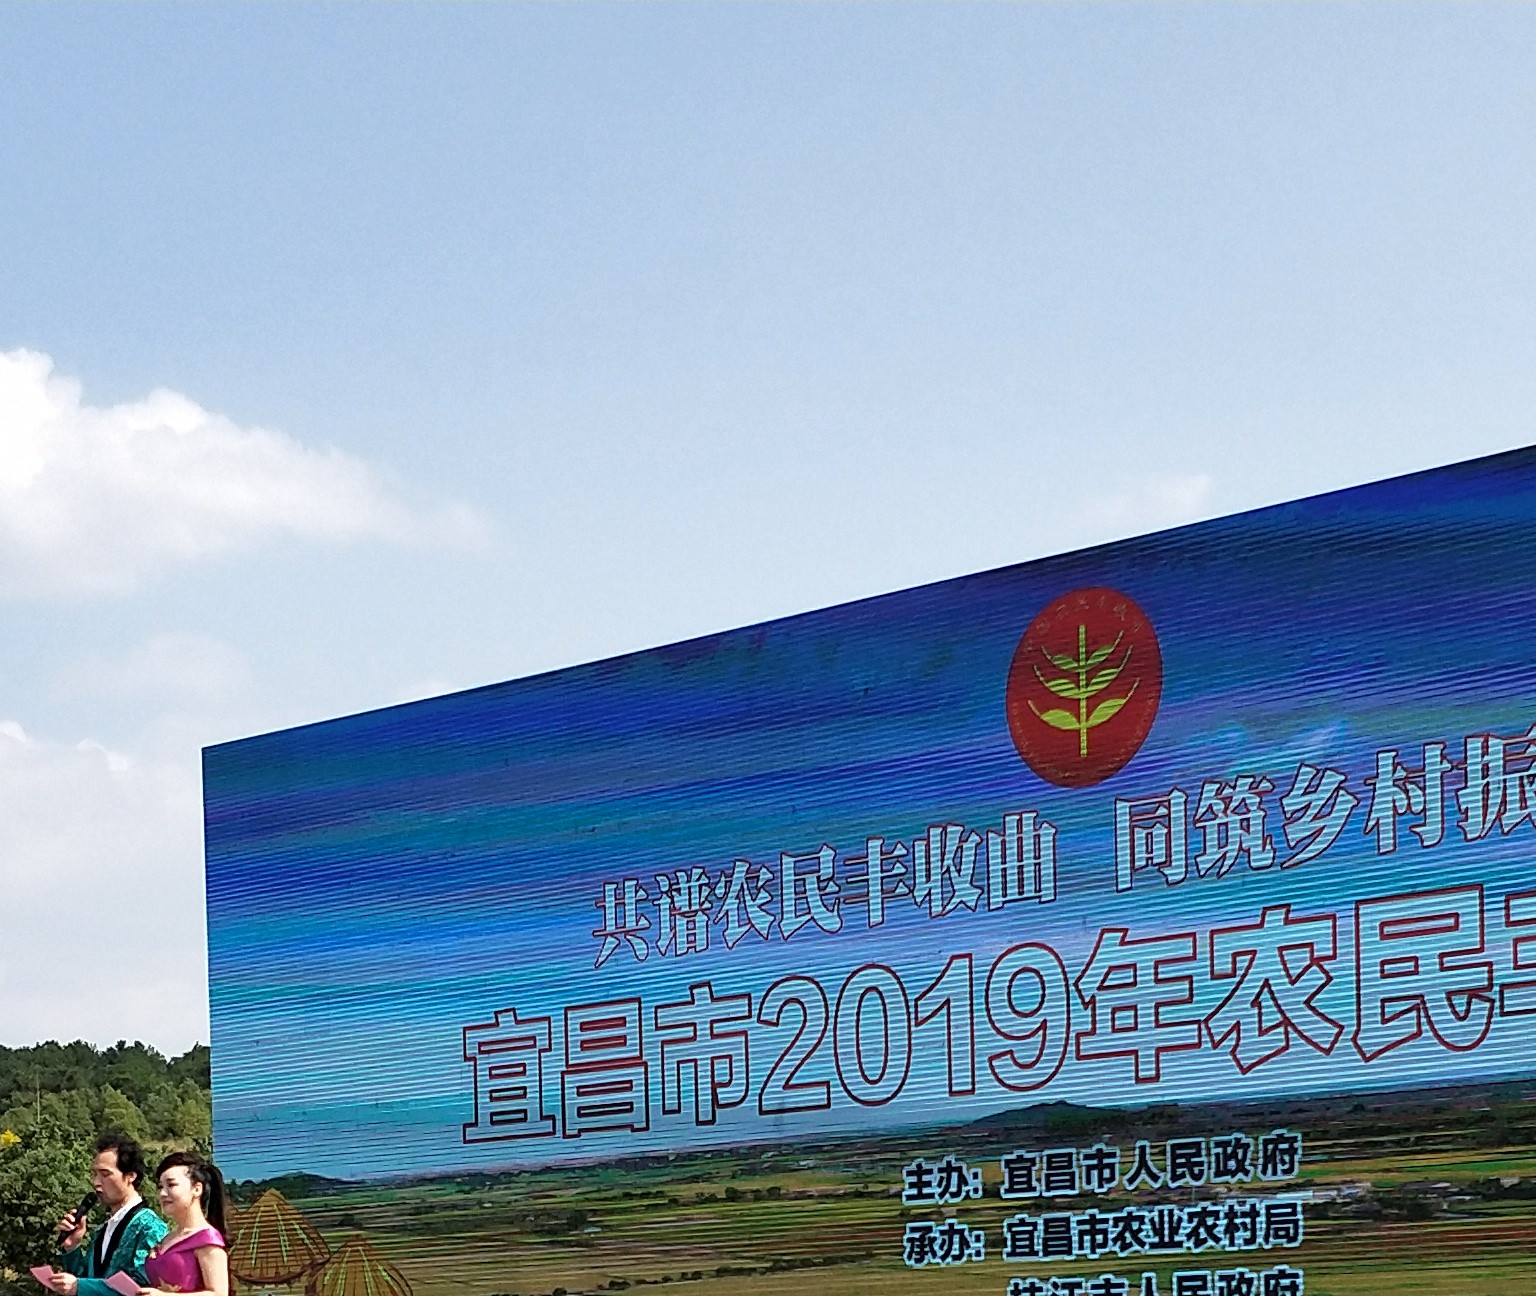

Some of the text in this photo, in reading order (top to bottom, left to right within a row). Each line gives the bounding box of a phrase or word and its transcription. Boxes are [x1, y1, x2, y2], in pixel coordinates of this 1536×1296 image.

[593, 810, 1058, 968] 共谱农民丰收曲
